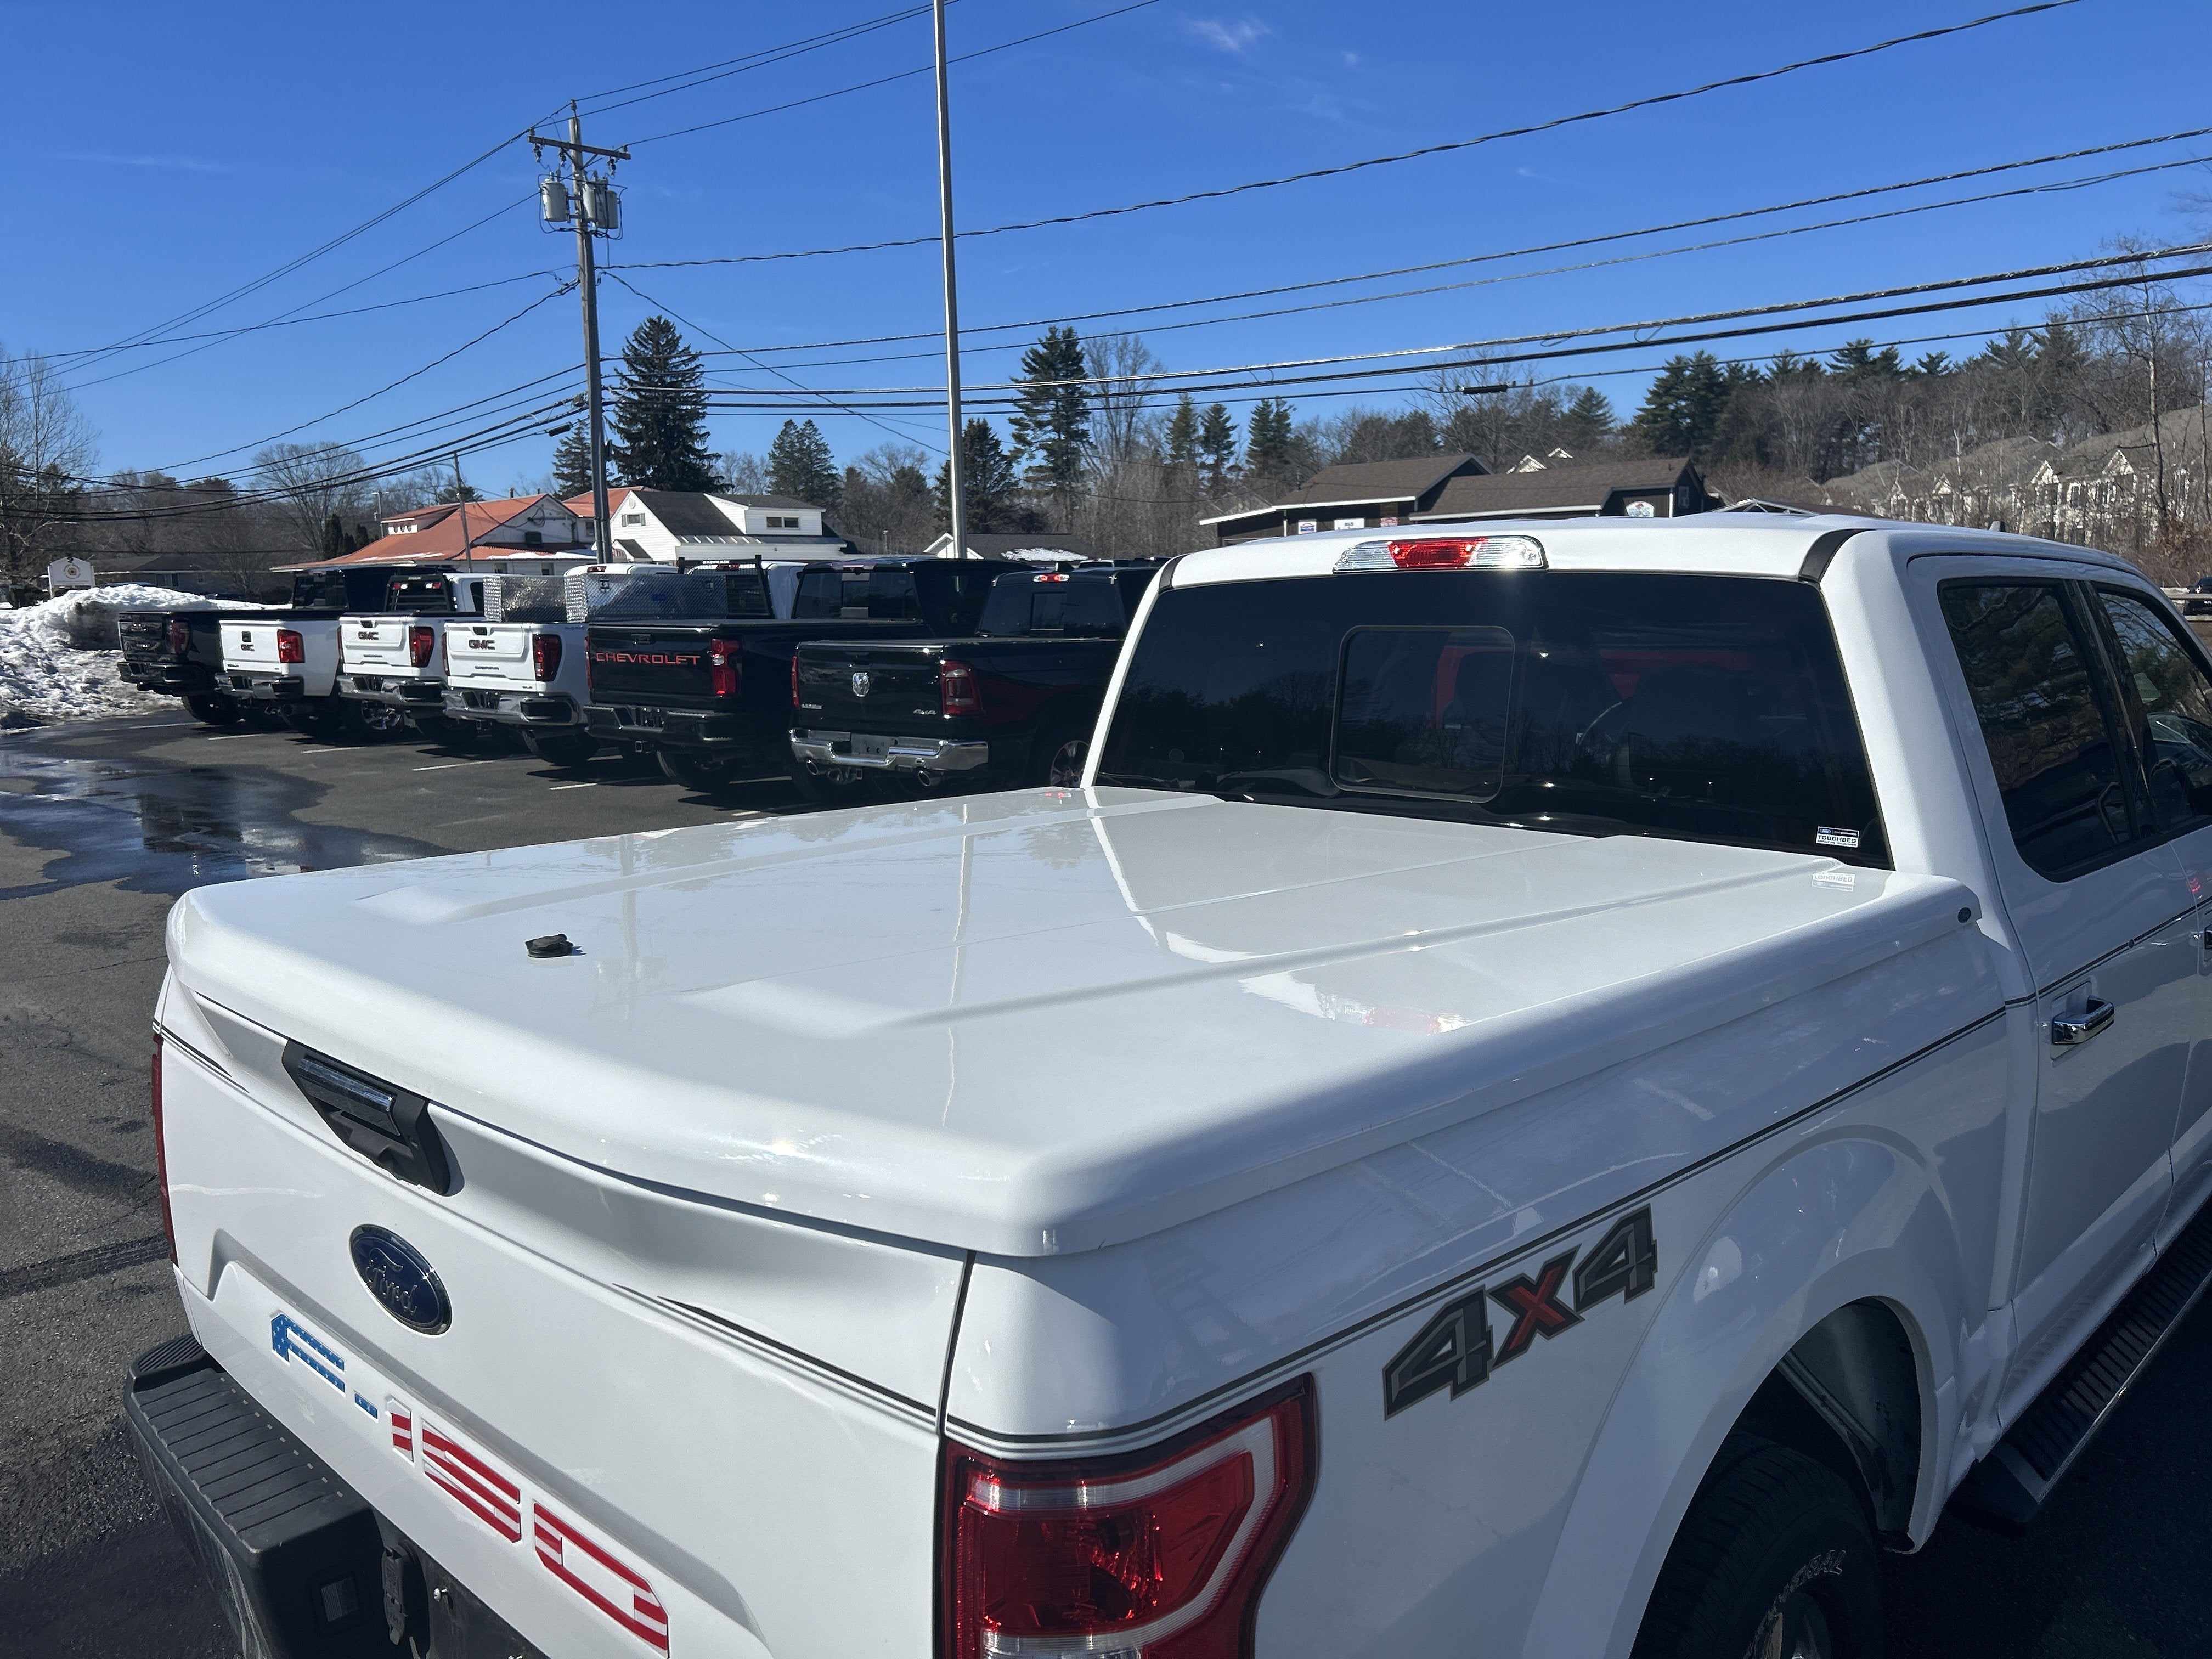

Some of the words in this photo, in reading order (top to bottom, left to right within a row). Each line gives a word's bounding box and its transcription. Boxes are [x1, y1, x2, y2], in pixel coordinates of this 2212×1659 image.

[358, 631, 380, 641] GMC
[469, 639, 496, 650] GMC
[596, 652, 701, 666] CHEVROLET
[1818, 834, 1857, 844] TOUGHBED
[365, 1247, 419, 1316] Ford
[270, 1312, 669, 1658] F-150
